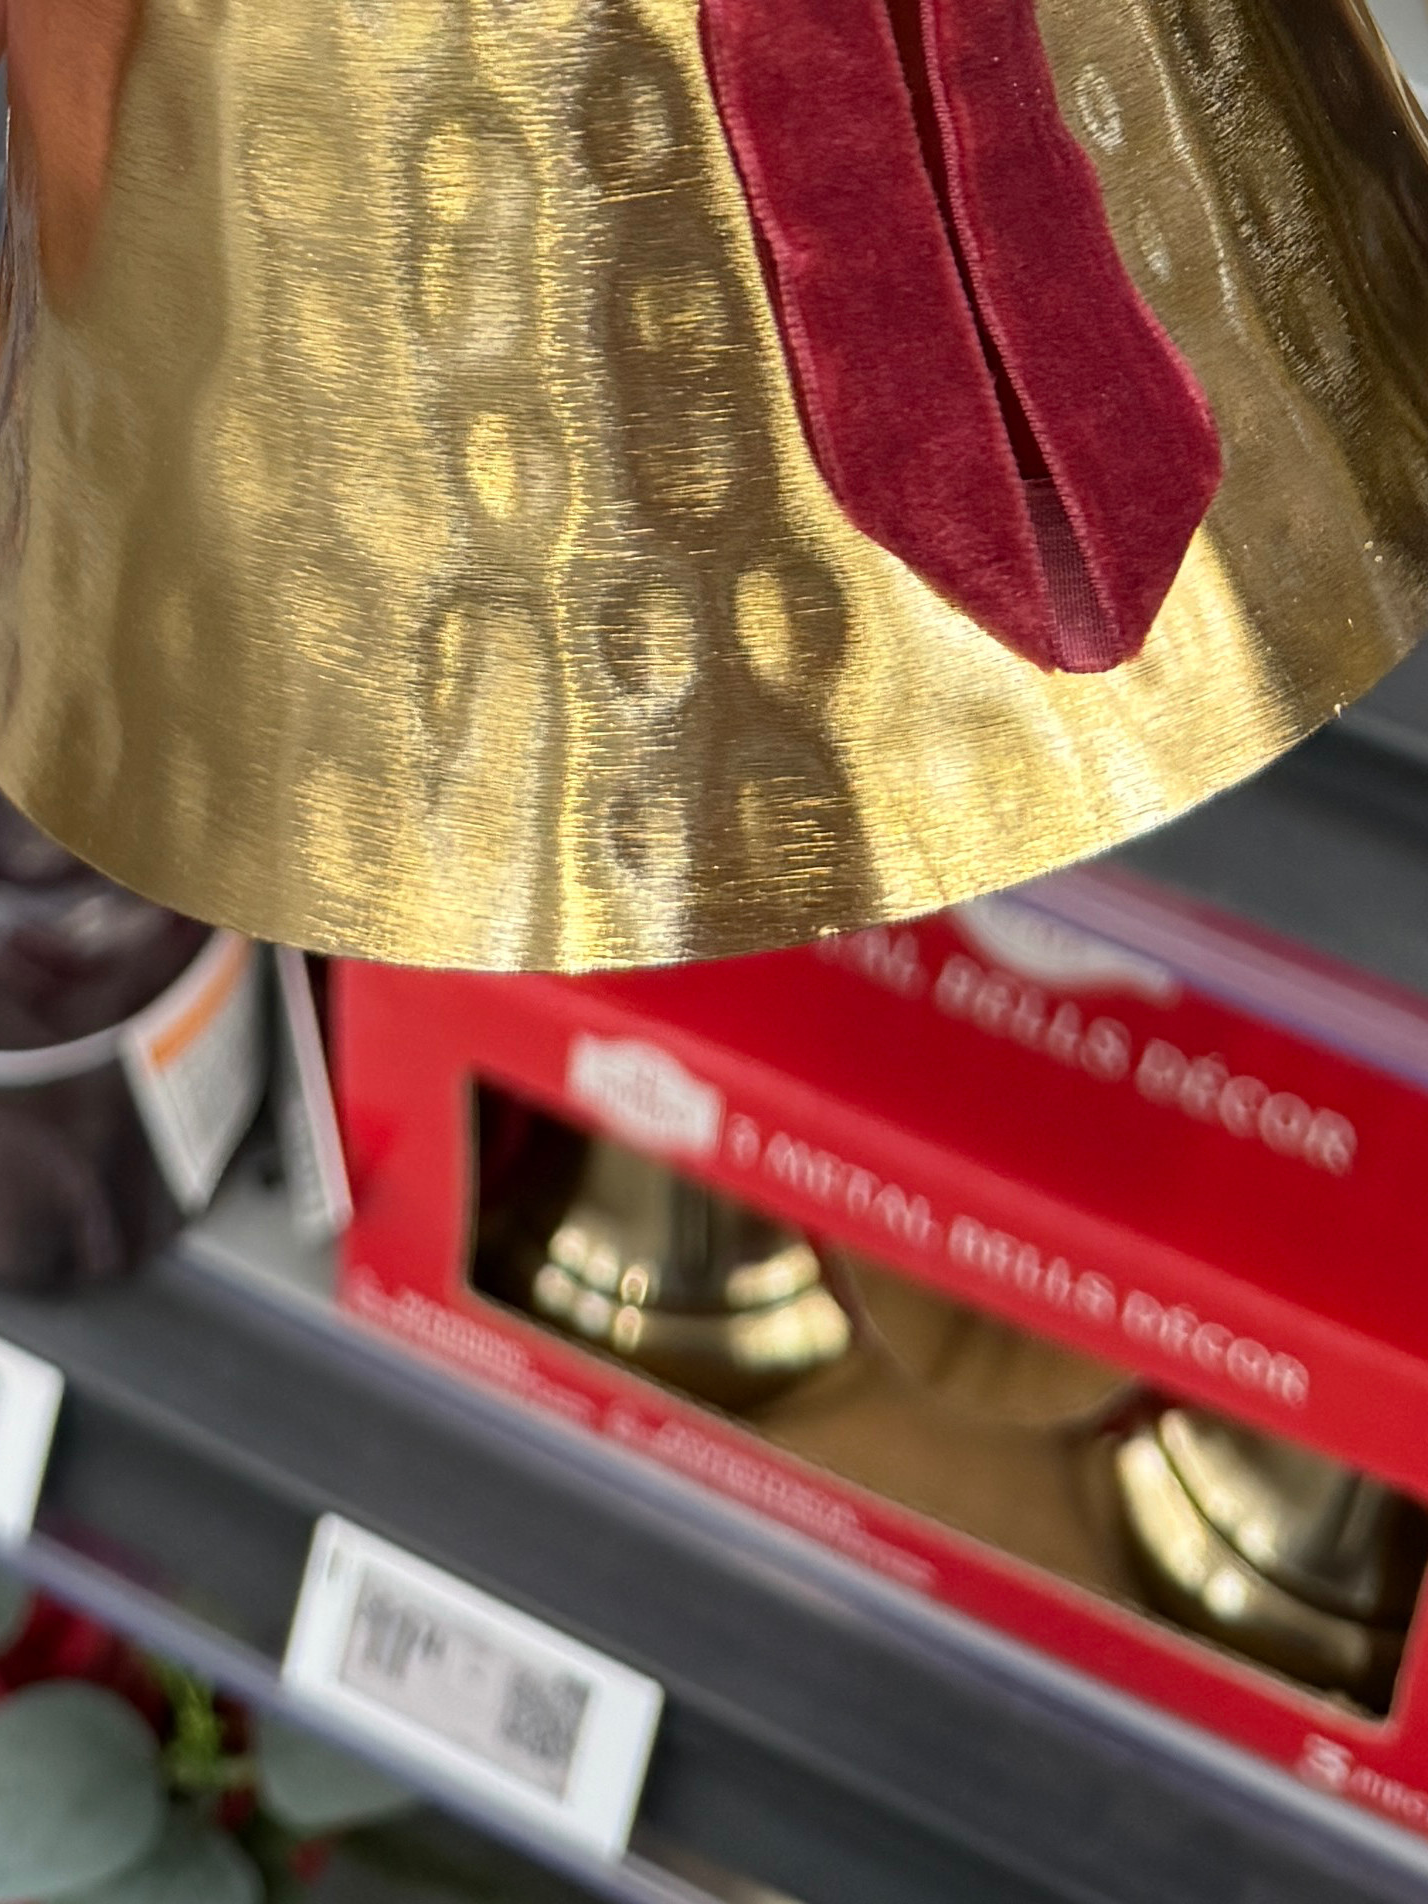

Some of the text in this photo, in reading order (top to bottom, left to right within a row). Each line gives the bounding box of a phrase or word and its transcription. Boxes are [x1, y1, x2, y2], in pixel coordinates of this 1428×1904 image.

[934, 952, 1133, 1083] BELLS
[766, 1130, 942, 1252] METAL
[948, 1214, 1117, 1324] BELLS
